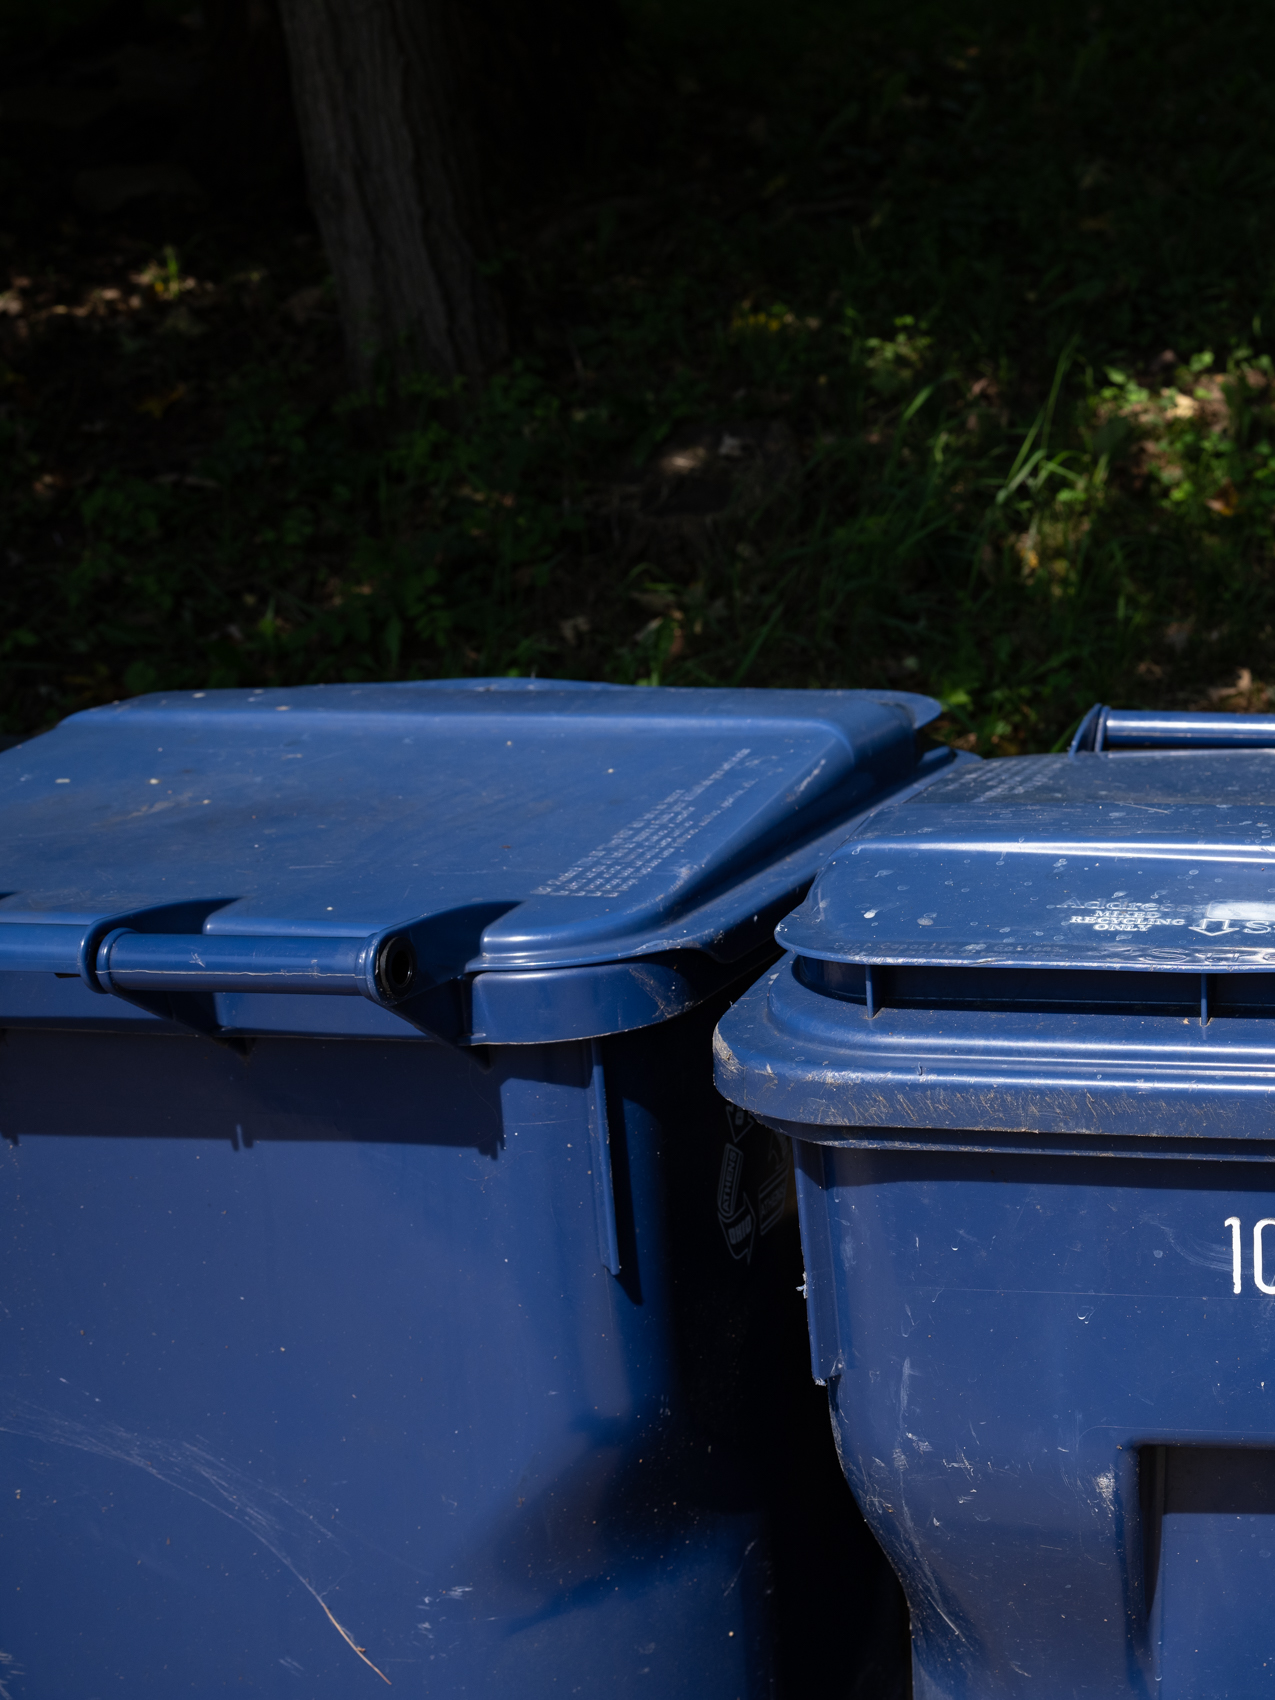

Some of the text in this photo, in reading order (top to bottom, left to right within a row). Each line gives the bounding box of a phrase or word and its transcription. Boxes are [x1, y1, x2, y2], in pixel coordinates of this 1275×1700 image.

[1094, 910, 1161, 919] MIXED
[1069, 916, 1186, 926] RECYCLING
[1093, 923, 1152, 932] ONLY
[721, 1149, 738, 1213] ATHENS
[727, 1213, 752, 1245] OHIO
